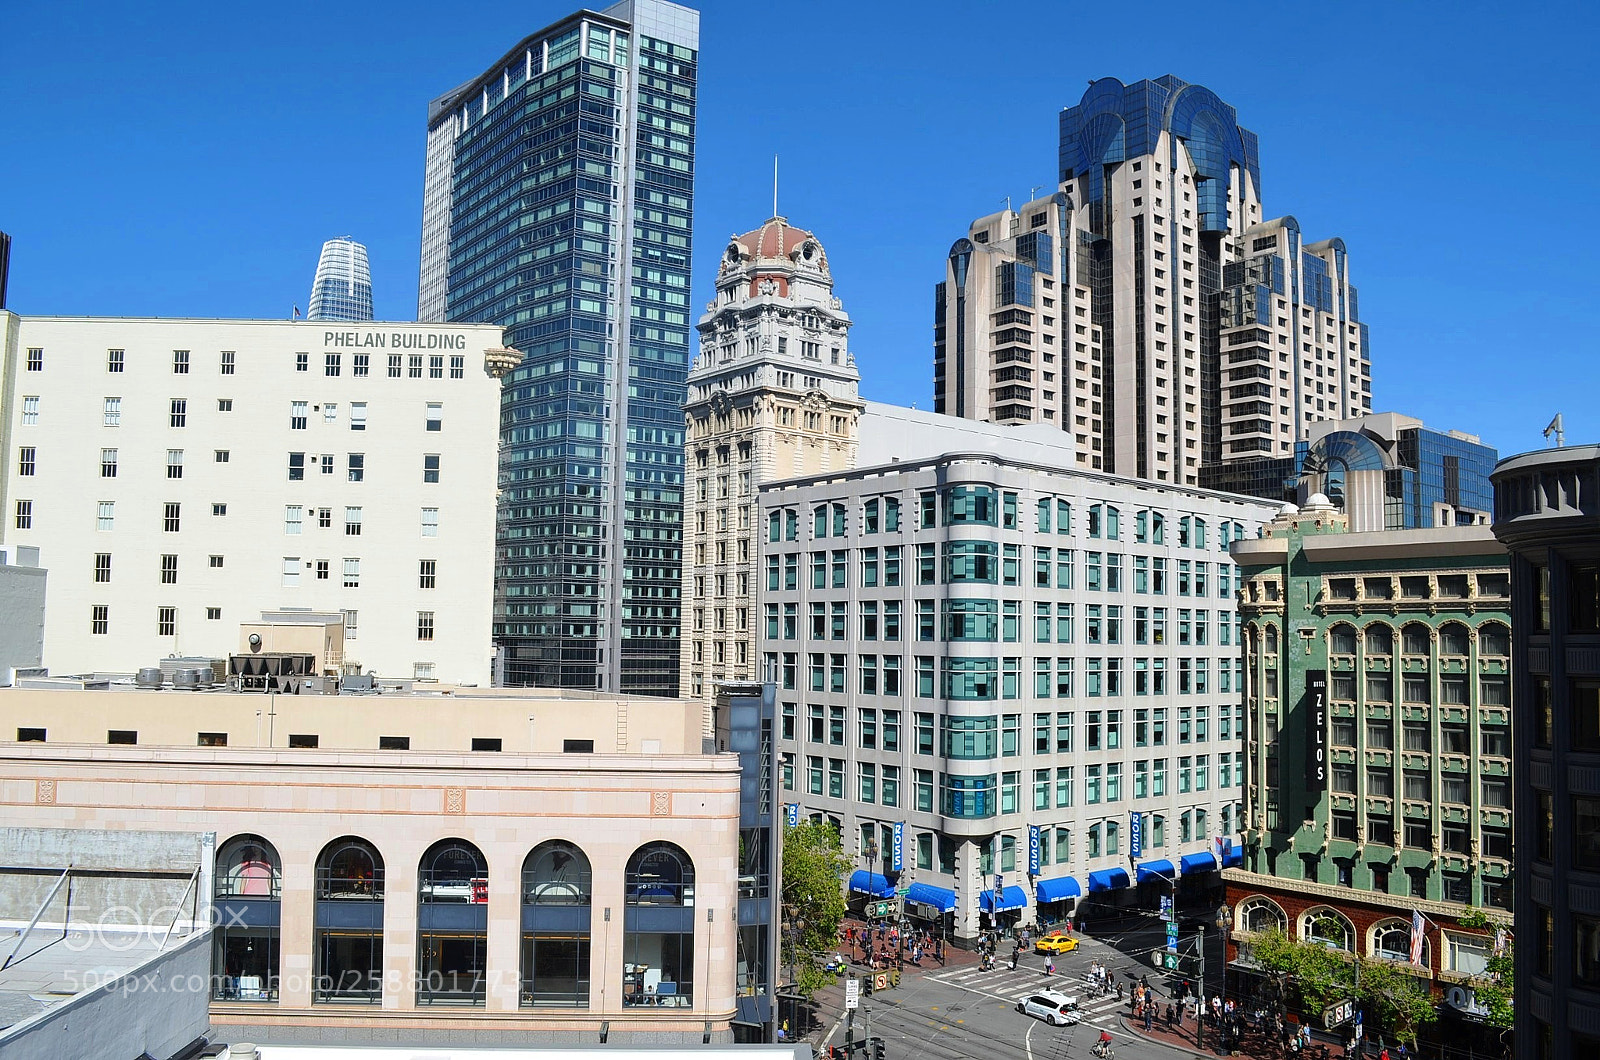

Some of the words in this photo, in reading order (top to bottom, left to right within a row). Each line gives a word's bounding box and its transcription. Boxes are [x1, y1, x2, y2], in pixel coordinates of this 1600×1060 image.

[324, 331, 386, 348] PHELAN
[391, 333, 466, 350] BUILDING
[1313, 680, 1326, 688] HOTEL
[1316, 693, 1324, 780] ZELOS
[789, 805, 797, 828] RO
[1131, 814, 1139, 853] ROSS
[894, 824, 902, 866] ROSS
[1030, 828, 1038, 870] ROSS
